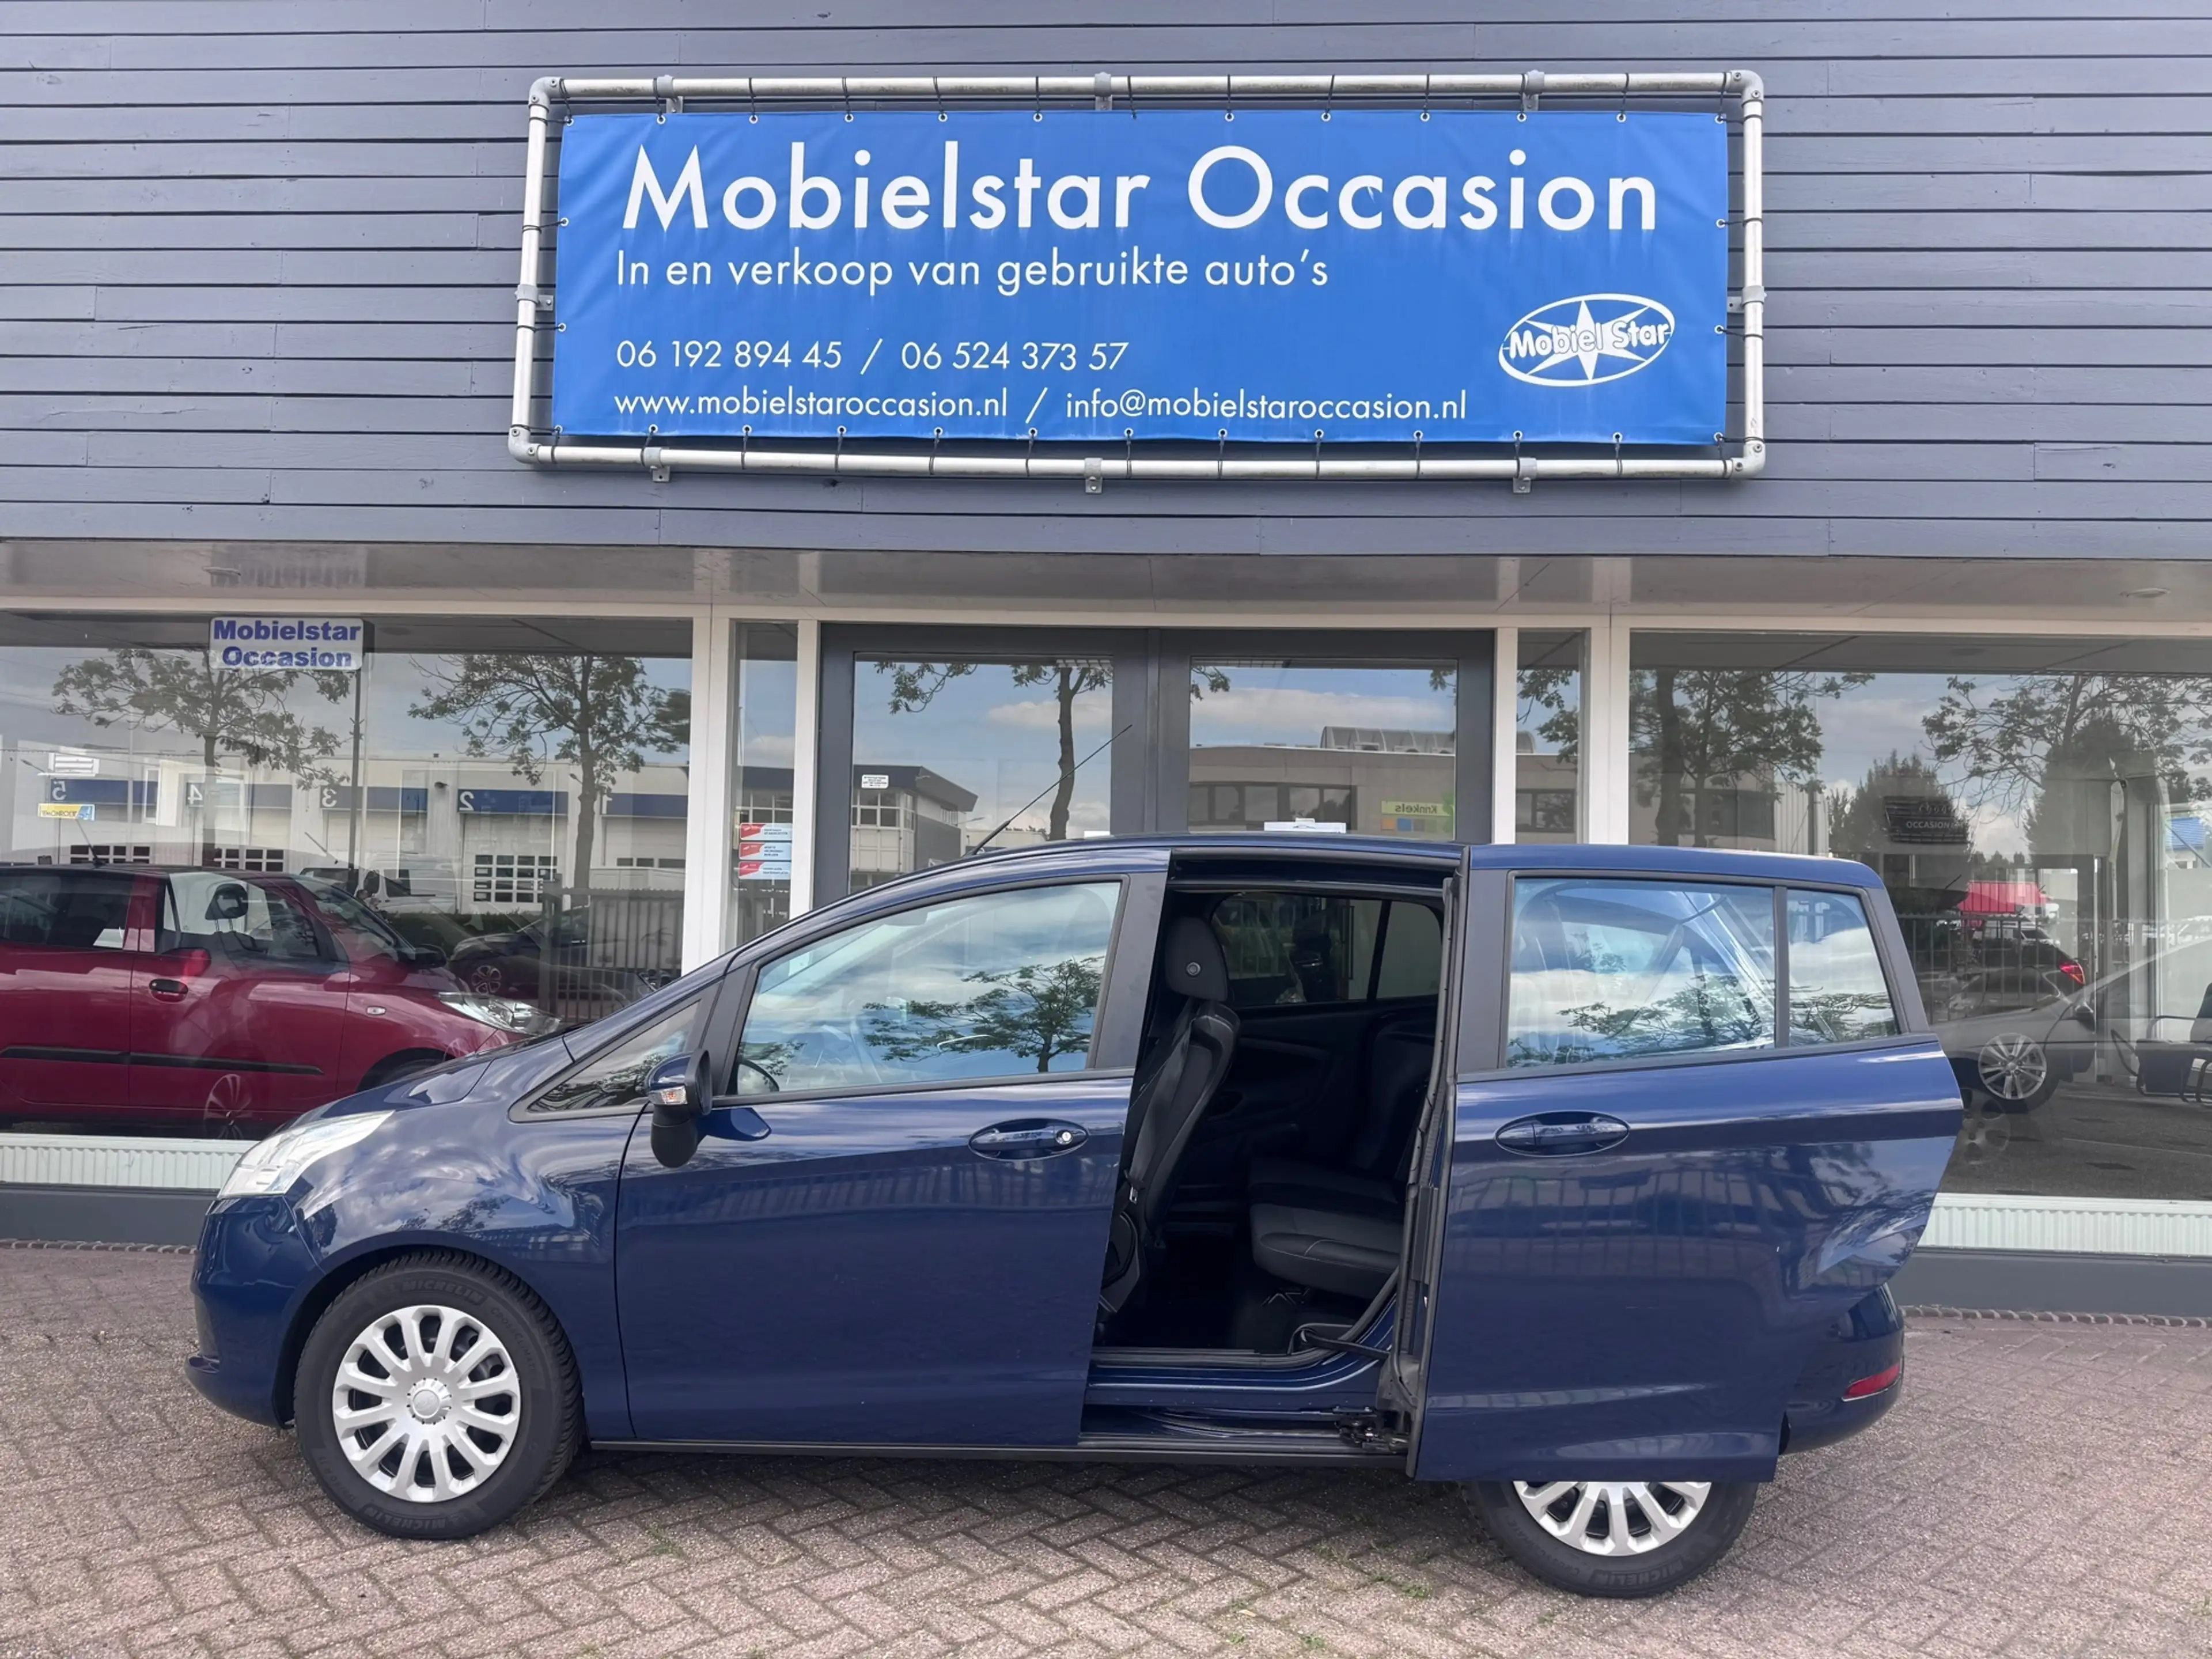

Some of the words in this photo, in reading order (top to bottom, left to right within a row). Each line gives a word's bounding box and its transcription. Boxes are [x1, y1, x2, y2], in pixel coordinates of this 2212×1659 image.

[622, 141, 1150, 232] Mobielstar
[1188, 146, 1656, 231] Occasion
[618, 250, 649, 286] In
[666, 262, 711, 286] en
[728, 247, 892, 297] verkoop
[908, 262, 979, 286] van
[998, 246, 1188, 297] gebruikte
[1205, 249, 1328, 286] auto's
[617, 340, 656, 368] 06
[672, 340, 721, 368] 192
[735, 340, 791, 368] 894
[802, 341, 841, 368] 45
[861, 338, 883, 375] /
[902, 341, 941, 369] 06
[953, 341, 1010, 369] 524
[1022, 342, 1076, 370] 373
[1089, 342, 1128, 370] 57
[1509, 321, 1603, 359] Mobiel
[1612, 320, 1669, 350] Star
[614, 385, 1007, 416] www.mobielstaroccasion.nl
[1025, 387, 1048, 424] /
[1066, 388, 1467, 419] info@mobielstaroccasion.nl
[214, 620, 362, 641] Mobielstar
[222, 646, 352, 666] Occasion
[402, 1279, 483, 1301] MICHELIN
